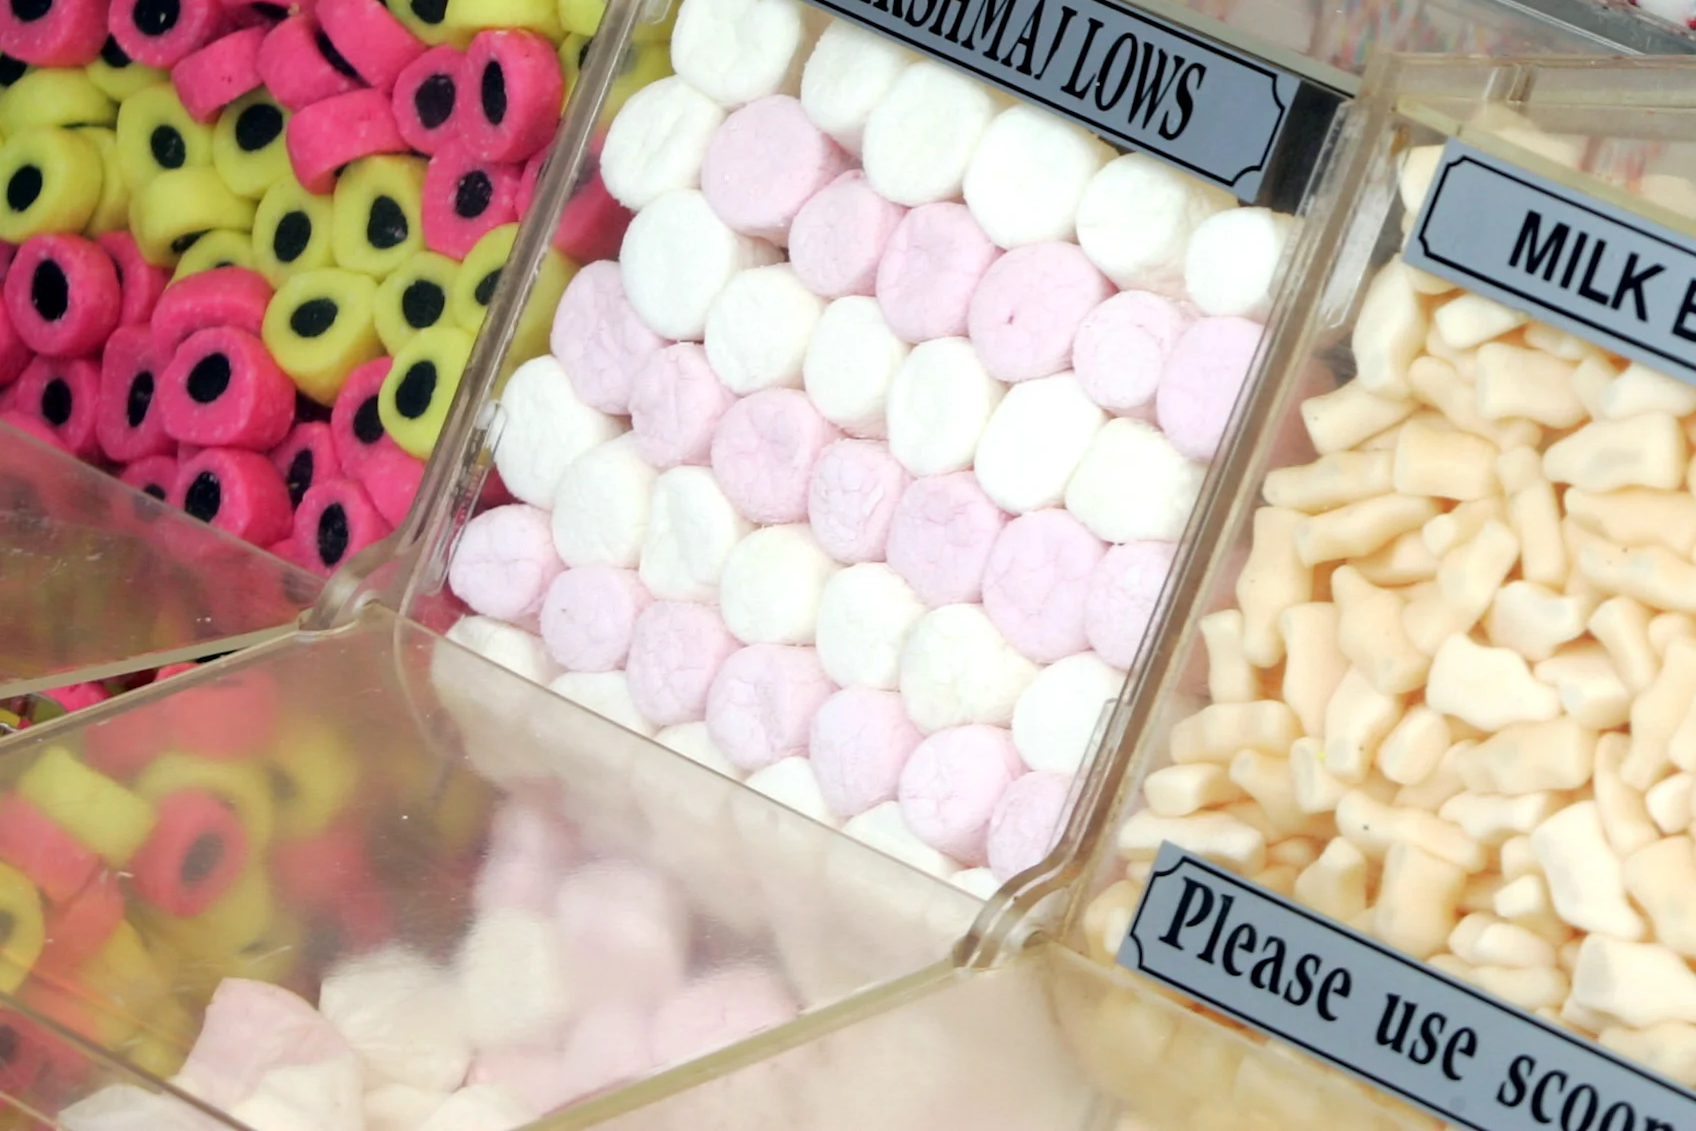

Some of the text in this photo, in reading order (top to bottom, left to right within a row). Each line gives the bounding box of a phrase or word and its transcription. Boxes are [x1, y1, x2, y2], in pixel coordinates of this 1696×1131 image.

[1507, 210, 1667, 323] MILK
[1157, 875, 1677, 1131] Please use scoo
